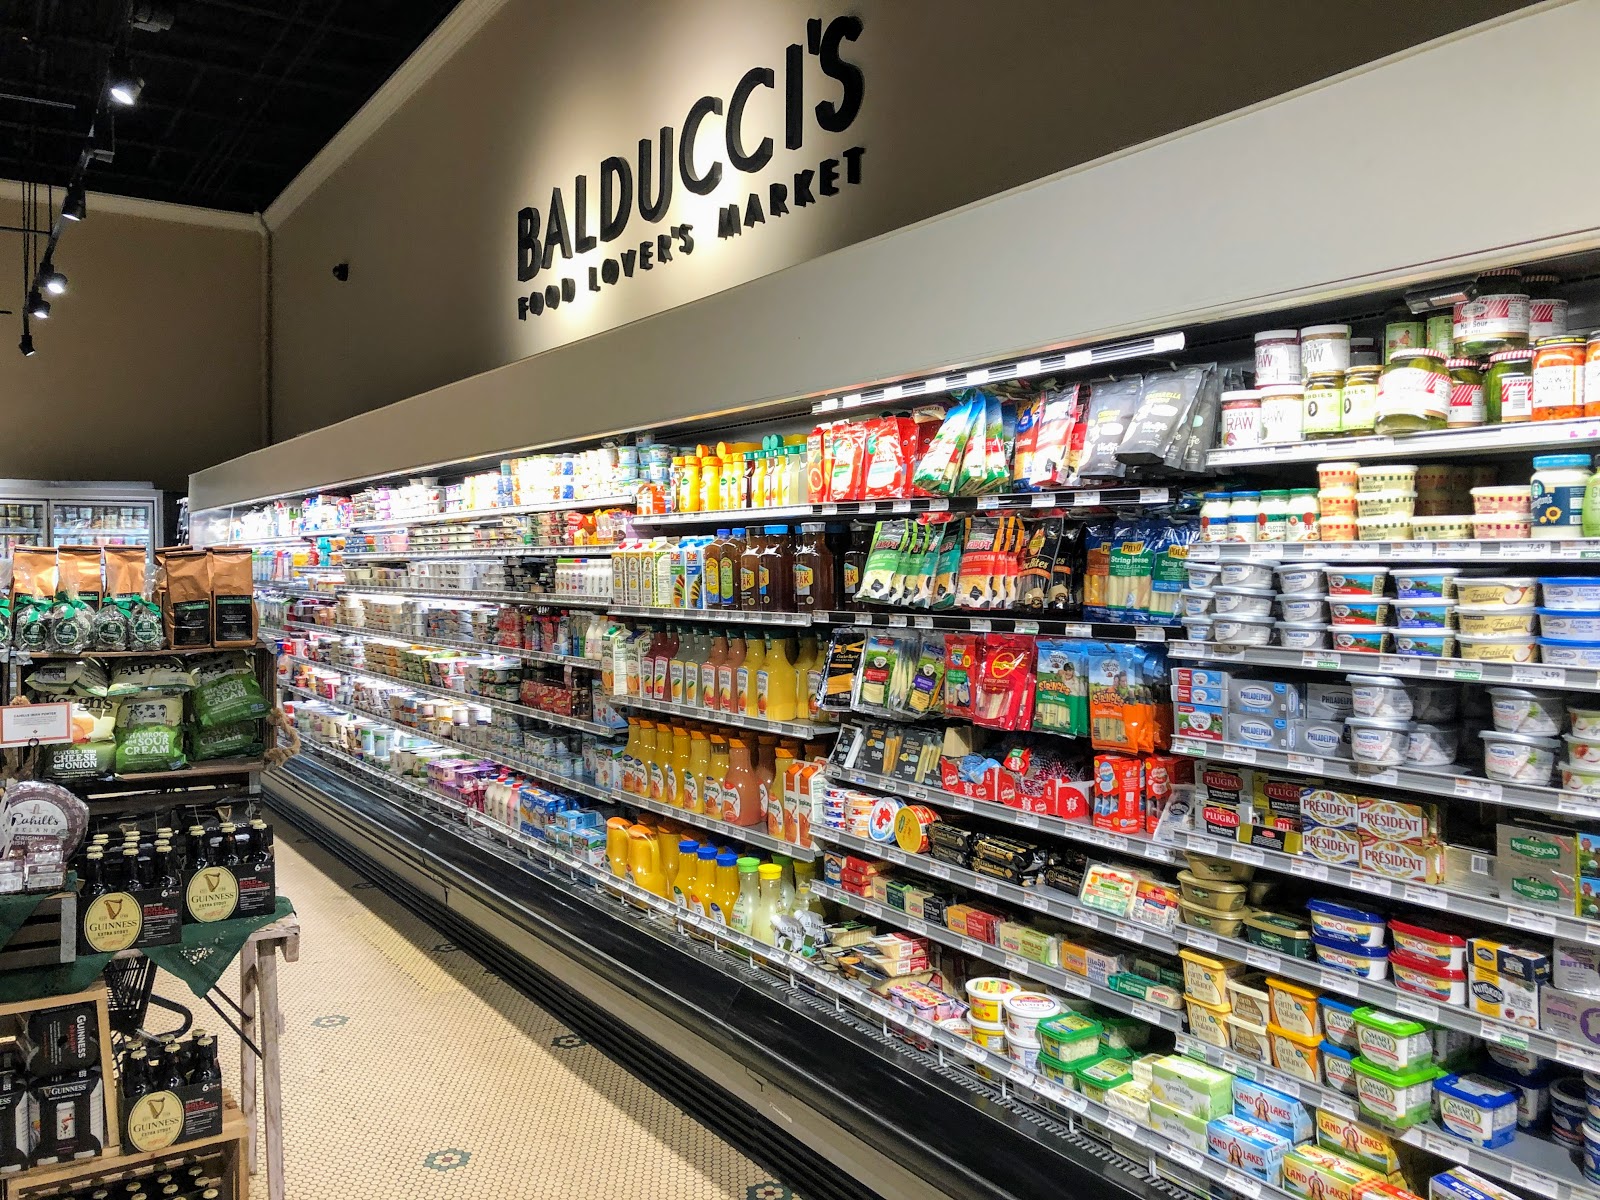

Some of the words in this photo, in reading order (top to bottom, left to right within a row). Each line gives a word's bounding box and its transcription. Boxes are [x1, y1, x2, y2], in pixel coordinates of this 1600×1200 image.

[517, 15, 865, 282] BALDUCCI'S
[518, 278, 576, 321] FOOD
[589, 223, 694, 292] LOVER'S
[717, 146, 865, 241] MARKET
[1226, 417, 1254, 431] RAW
[216, 683, 244, 696] SOUR
[1240, 690, 1272, 702] PHILADELPHIA
[207, 690, 248, 707] CREAM
[1322, 694, 1352, 705] PHILADELP
[125, 731, 169, 739] SHAMROCK
[1240, 725, 1272, 737] PHILADELPHIA
[138, 738, 169, 747] SOUR
[1307, 733, 1340, 745] PHILADELPHIA
[125, 745, 170, 756] CREAM
[53, 754, 98, 764] CHEESE
[53, 762, 65, 770] and
[65, 760, 97, 770] ONION
[1206, 775, 1239, 788] PLUGRÁ
[1269, 787, 1299, 798] PLUGR
[1303, 798, 1354, 818] PRÉSIDENT
[1206, 811, 1238, 825] PLUGRÁ
[1361, 812, 1419, 832] PRÉSIDENT
[1304, 834, 1356, 855] PRÉSIDENT
[1365, 849, 1423, 871] PRÉSIDENT
[161, 889, 169, 897] 6
[191, 892, 234, 904] GUINNESS
[89, 920, 137, 932] GUINNESS
[1187, 969, 1203, 980] earth
[1275, 999, 1293, 1012] earth
[1332, 1013, 1353, 1026] SMAR
[76, 1014, 87, 1059] GUINNESS
[1367, 1029, 1391, 1044] SMART
[51, 1084, 87, 1095] GUINNESS
[202, 1083, 209, 1092] 6
[1366, 1079, 1390, 1094] SMART
[1236, 1090, 1254, 1105] LAND
[1254, 1095, 1270, 1112] O
[1270, 1104, 1291, 1121] LAKES
[133, 1118, 180, 1133] GUINNESS
[1320, 1118, 1342, 1135] LAND
[1342, 1124, 1359, 1143] O
[1360, 1134, 1384, 1152] LAKES
[1208, 1135, 1227, 1150] LAND
[1228, 1140, 1242, 1158] O
[1243, 1149, 1264, 1167] LAKES
[1286, 1167, 1307, 1183] LAND
[1308, 1174, 1325, 1193] O
[1325, 1185, 1349, 1200] LAKES
[1451, 1181, 1485, 1200] BUTTER
